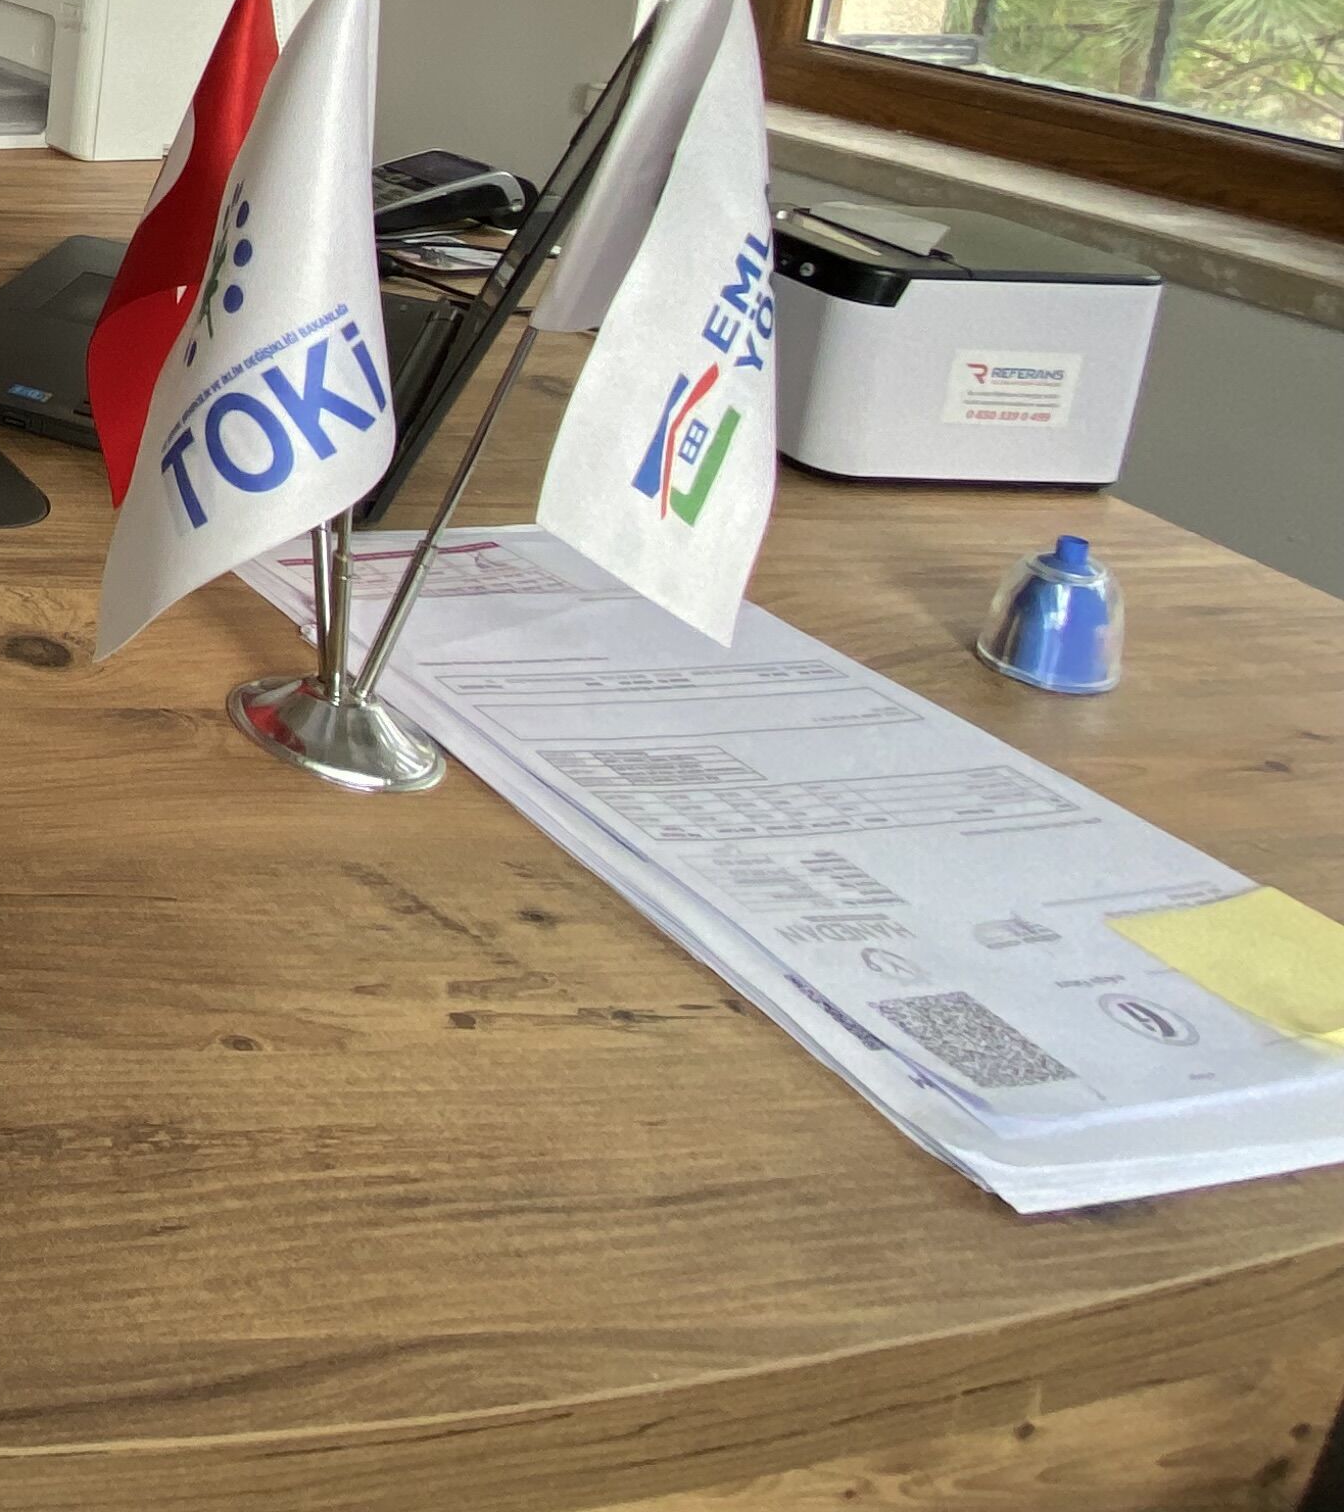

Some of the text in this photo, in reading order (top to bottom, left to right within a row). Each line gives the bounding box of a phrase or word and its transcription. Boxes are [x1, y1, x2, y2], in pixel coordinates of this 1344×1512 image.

[702, 232, 771, 354] EML
[298, 303, 349, 338] BAKANLIĞI
[990, 367, 1065, 381] REFERANS
[775, 918, 917, 945] HANEDAN
